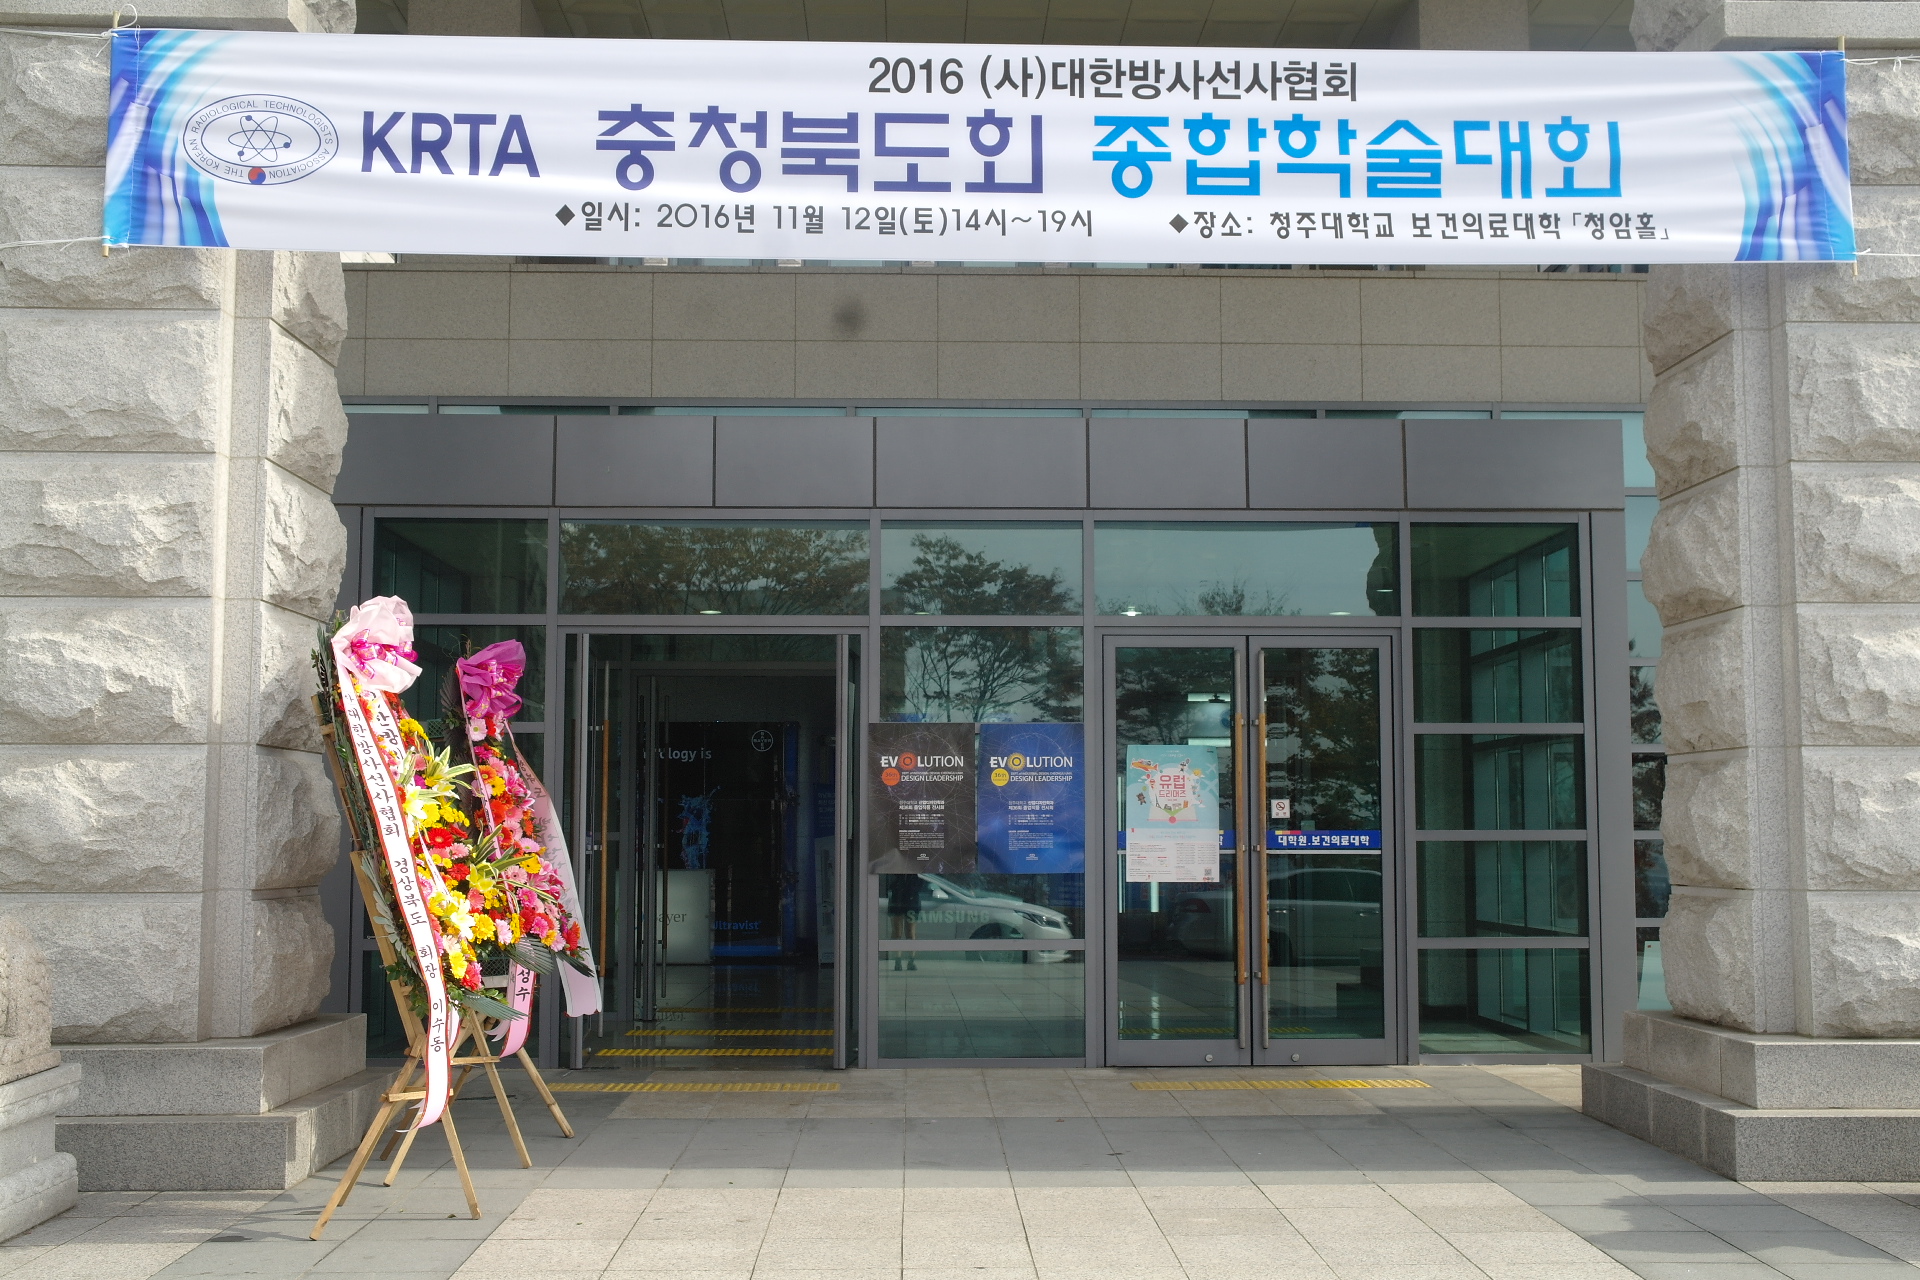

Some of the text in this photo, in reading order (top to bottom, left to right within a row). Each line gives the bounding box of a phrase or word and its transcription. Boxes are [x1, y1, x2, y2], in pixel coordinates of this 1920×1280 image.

[867, 54, 1359, 102] 2016 (사)대한방사선사협회
[188, 99, 334, 179] THE KOREAN RADIOLOGICAL TECHNOLOGISTS ASSOCIATION
[361, 103, 1622, 199] KRTA 충청북도회 종합학술대회
[581, 201, 1093, 237] 일시: 2016년 11월 12일(토)14시~19시
[1193, 211, 1253, 239] 장소:
[1269, 211, 1395, 239] 청주대학교
[1411, 212, 1561, 240] 보건의료대학
[880, 754, 964, 769] EVOLUTION
[989, 754, 1073, 770] EVOLUTION
[1159, 774, 1187, 790] 유럽
[1158, 789, 1187, 798] 드리머즈
[1277, 834, 1370, 847] 대학원.보건의료대학
[655, 912, 687, 926] ayer
[906, 909, 990, 924] SAMSUNG
[394, 857, 427, 926] 경상북도
[418, 944, 438, 979] 회장
[429, 998, 445, 1053] 이수동
